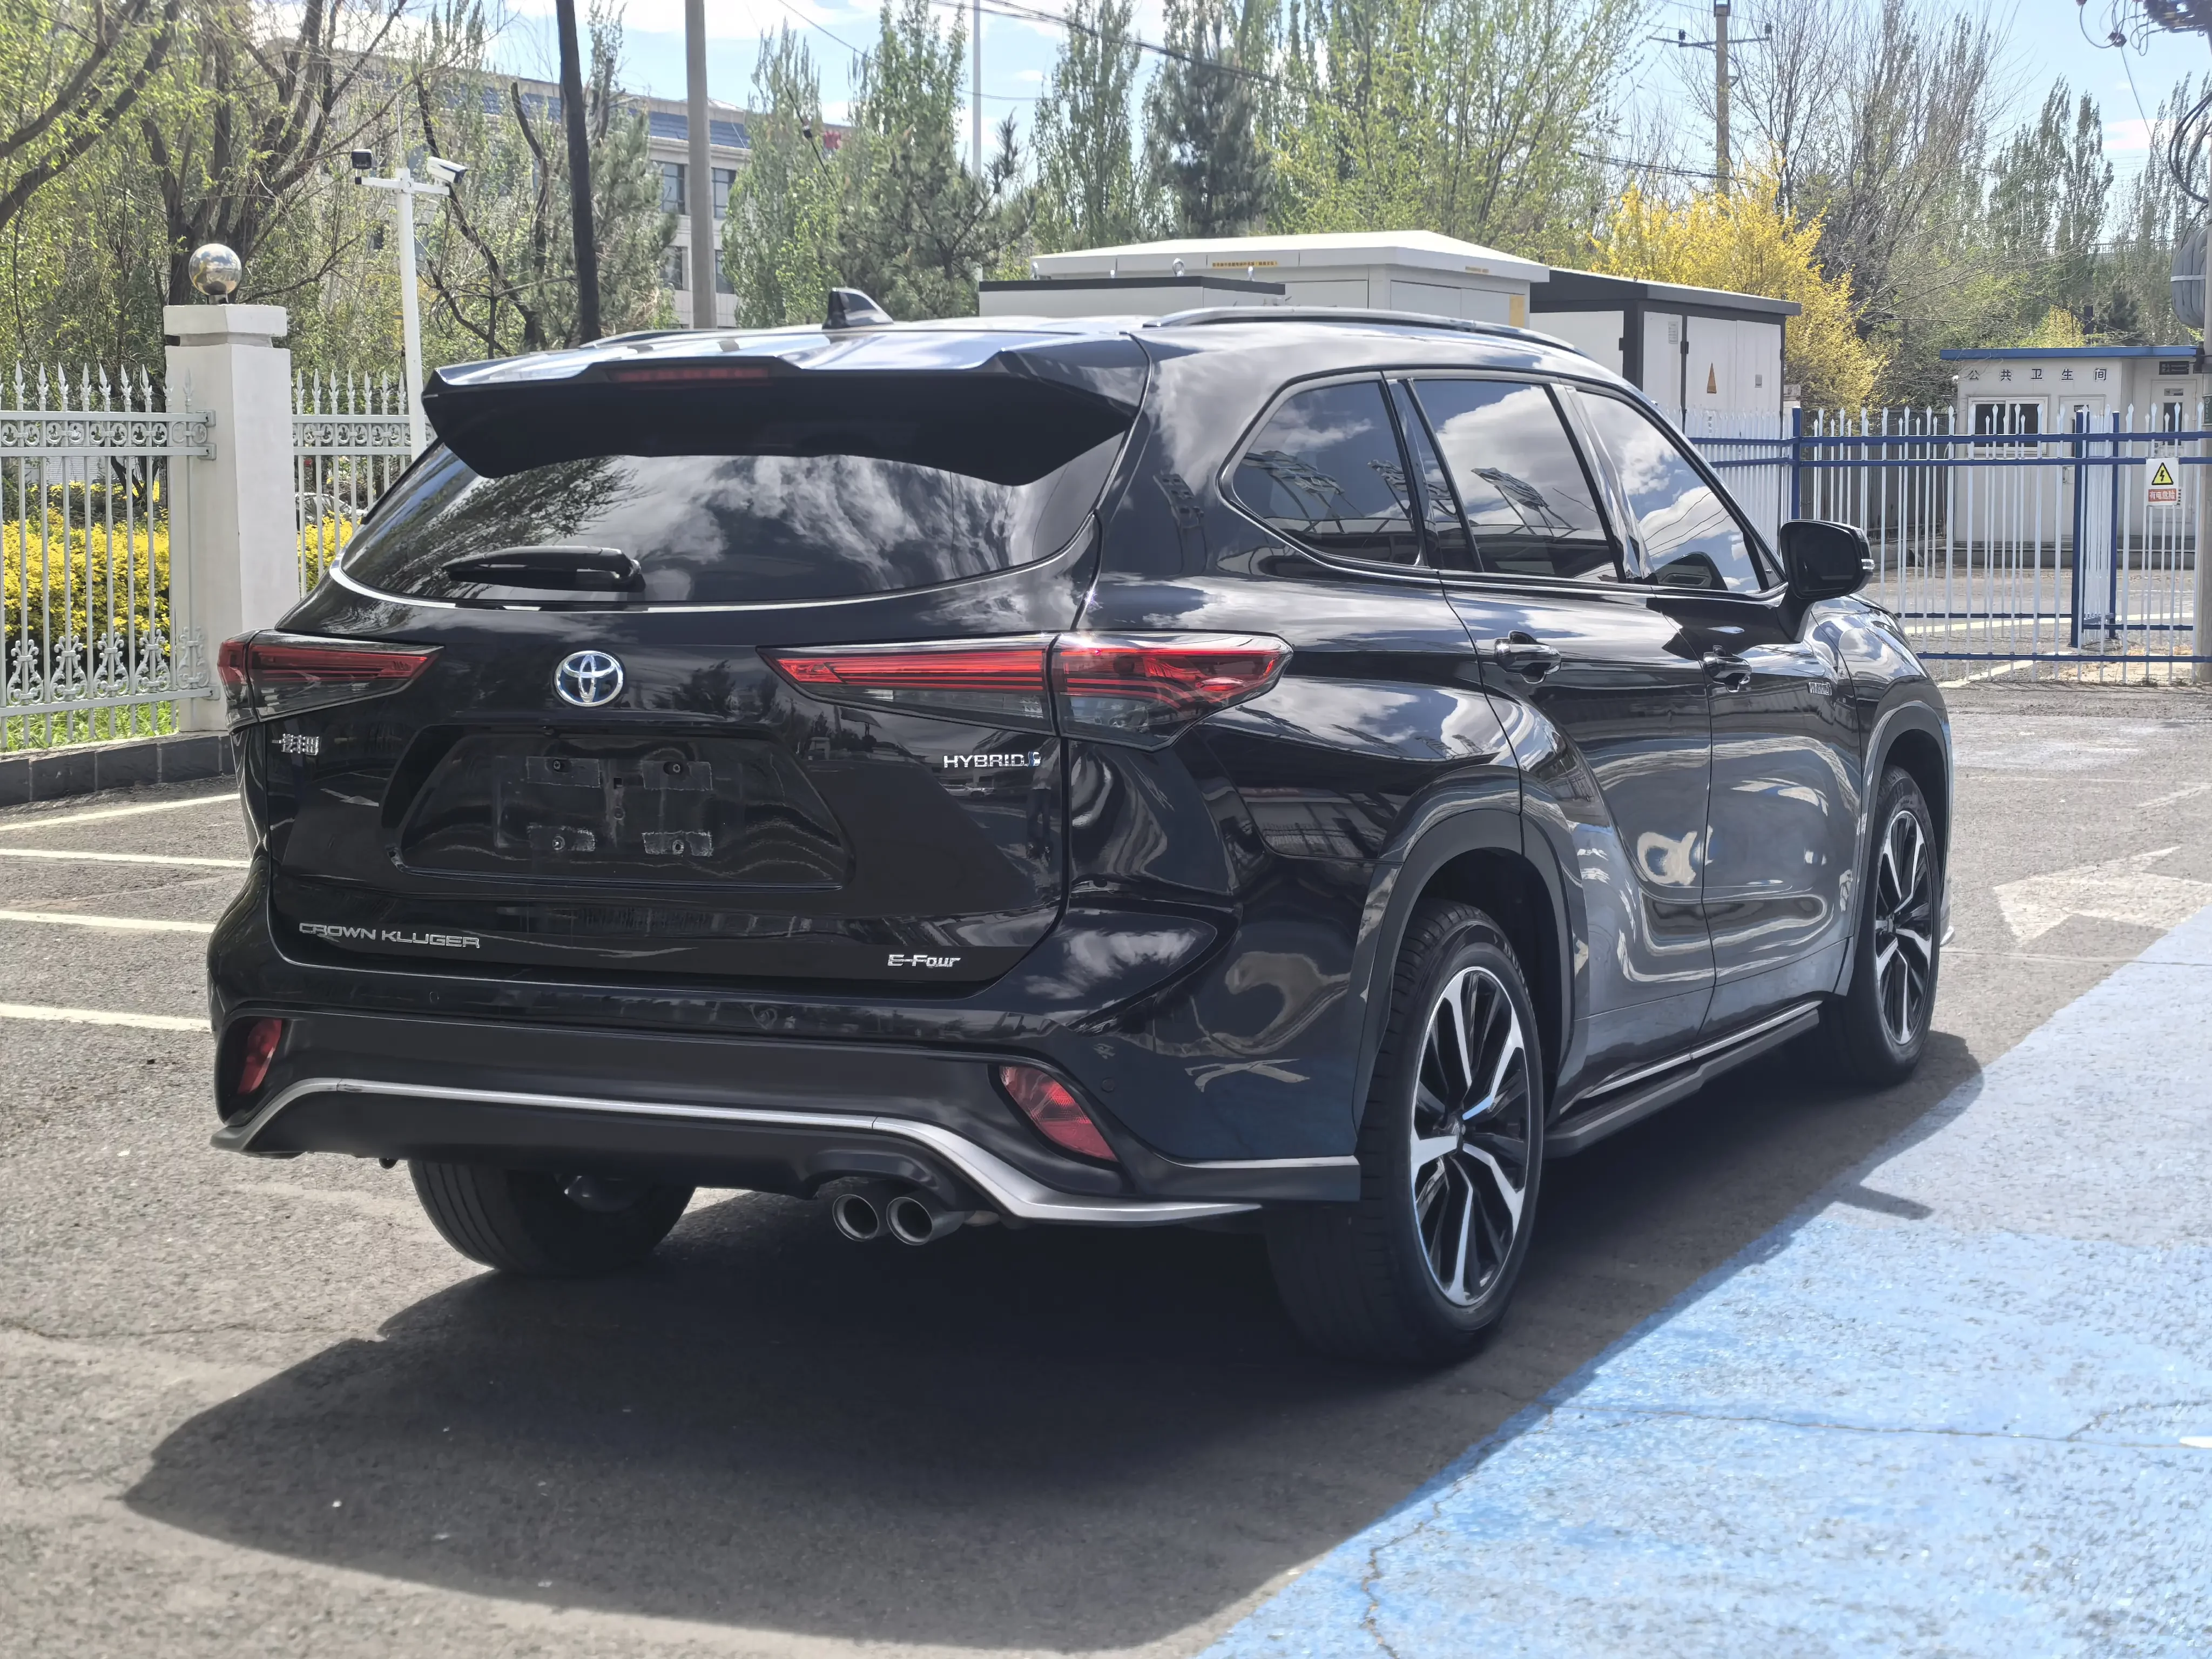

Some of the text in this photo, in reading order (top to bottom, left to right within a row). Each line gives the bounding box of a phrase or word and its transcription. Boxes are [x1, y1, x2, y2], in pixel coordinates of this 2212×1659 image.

[1969, 368, 2107, 381] 公共卫生间
[943, 754, 1025, 768] HYBRID
[299, 923, 480, 948] CROWN KLUGER
[887, 954, 961, 968] E-Four
